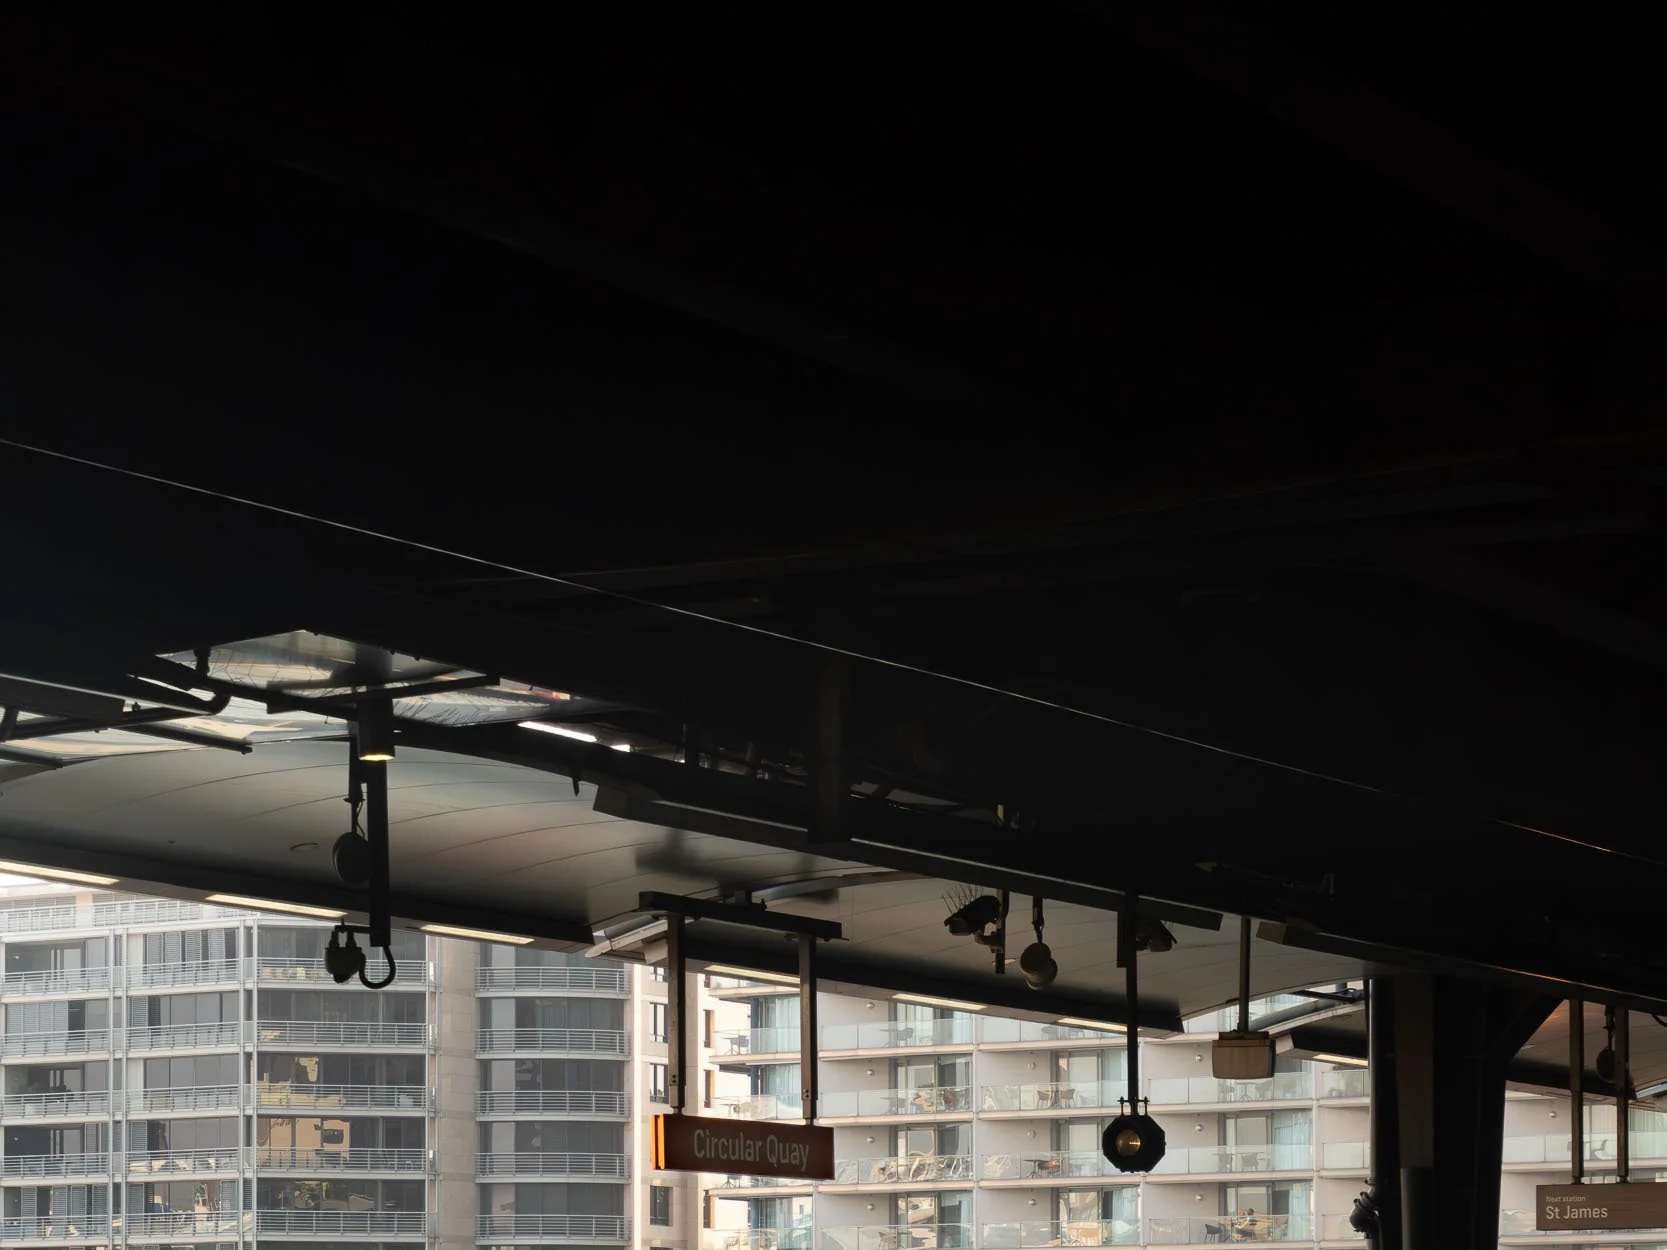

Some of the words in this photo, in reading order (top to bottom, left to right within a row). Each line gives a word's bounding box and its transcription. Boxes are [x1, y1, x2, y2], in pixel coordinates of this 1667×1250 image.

[693, 1129, 763, 1162] Circular
[766, 1134, 809, 1172] Quay
[1546, 1206, 1561, 1220] St
[1563, 1205, 1608, 1219] James
